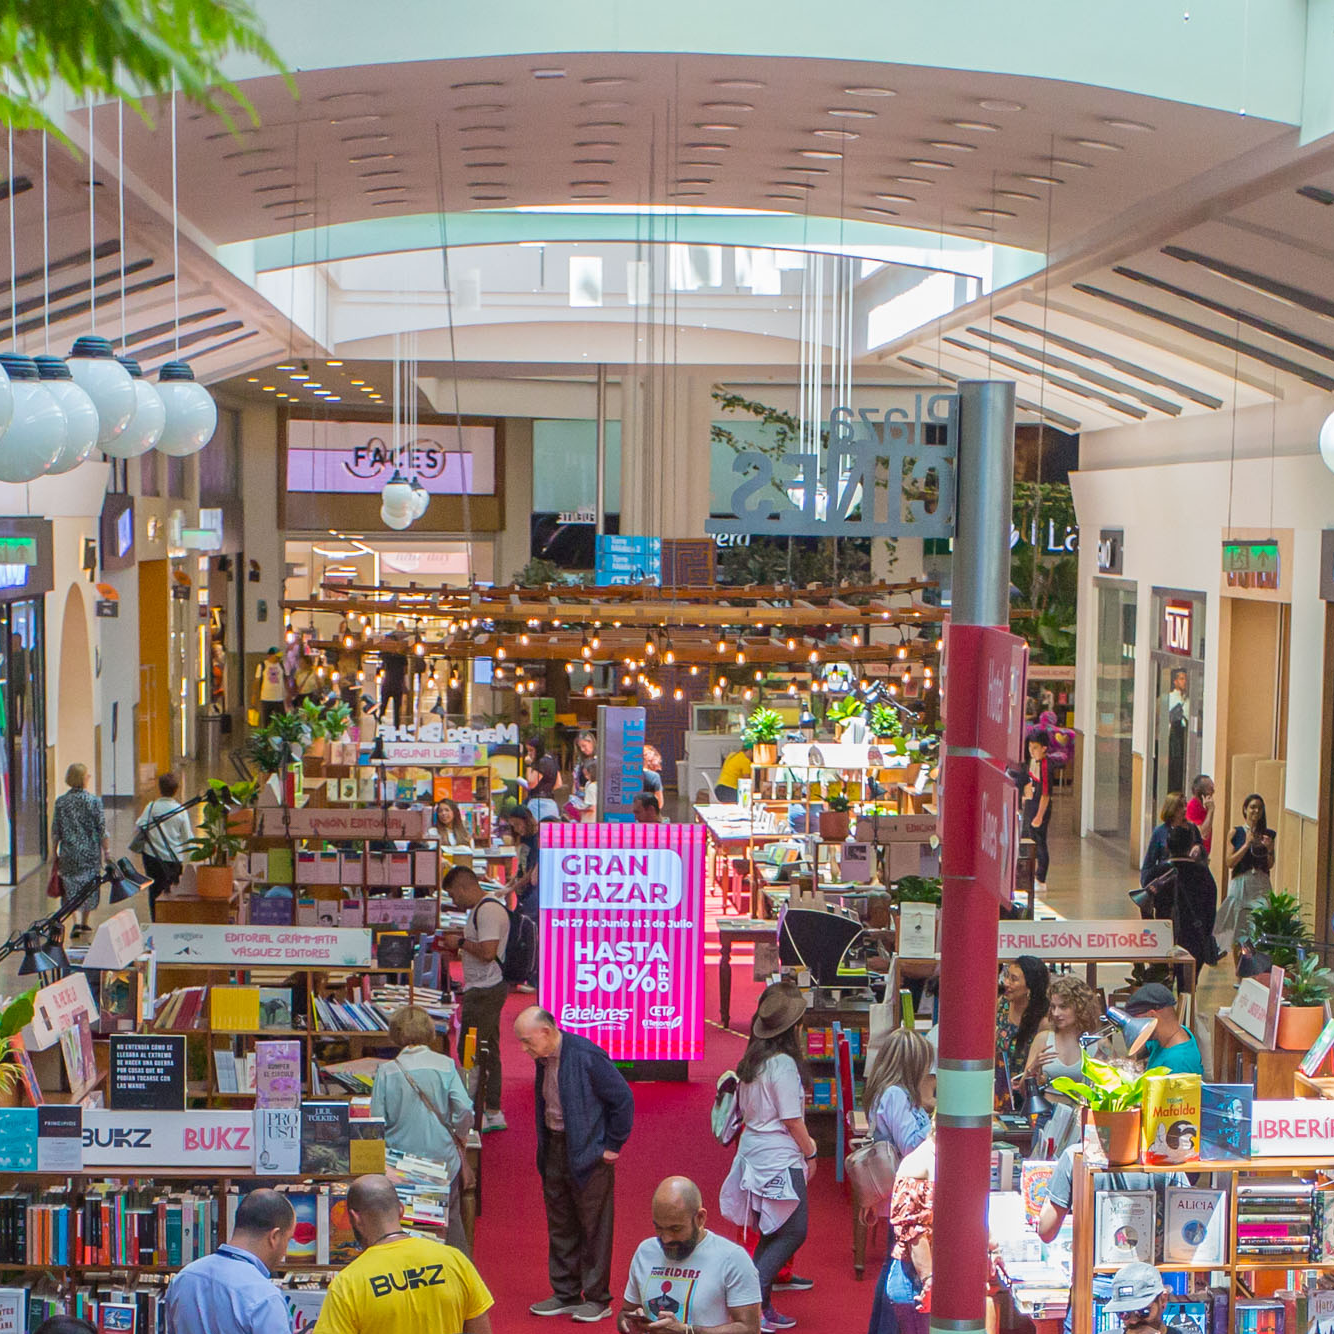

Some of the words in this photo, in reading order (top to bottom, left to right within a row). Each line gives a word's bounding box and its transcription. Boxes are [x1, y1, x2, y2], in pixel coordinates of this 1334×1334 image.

[621, 718, 644, 805] FUENTE
[561, 854, 648, 876] GRAN
[561, 882, 668, 904] BAZAR
[551, 918, 569, 928] Del
[571, 918, 583, 928] 27
[585, 918, 599, 928] de
[601, 918, 630, 929] Junio
[632, 918, 642, 928] al
[643, 919, 651, 928] 3
[652, 919, 666, 928] de
[667, 919, 693, 929] Julio
[999, 932, 1082, 949] FRAILEJÓN
[1086, 932, 1159, 948] EDITORES
[285, 948, 330, 958] EDITORES
[574, 941, 669, 962] HASTA
[575, 963, 657, 993] 50%
[658, 964, 669, 993] OFF
[267, 1112, 299, 1126] PRO
[1153, 1104, 1196, 1118] Mafalda
[83, 1128, 152, 1148] BUKZ
[184, 1127, 251, 1151] BUKZ
[268, 1126, 298, 1139] UST
[1177, 1199, 1214, 1211] ALICIA
[369, 1263, 446, 1298] BUKZ
[664, 1267, 701, 1279] ELDERS
